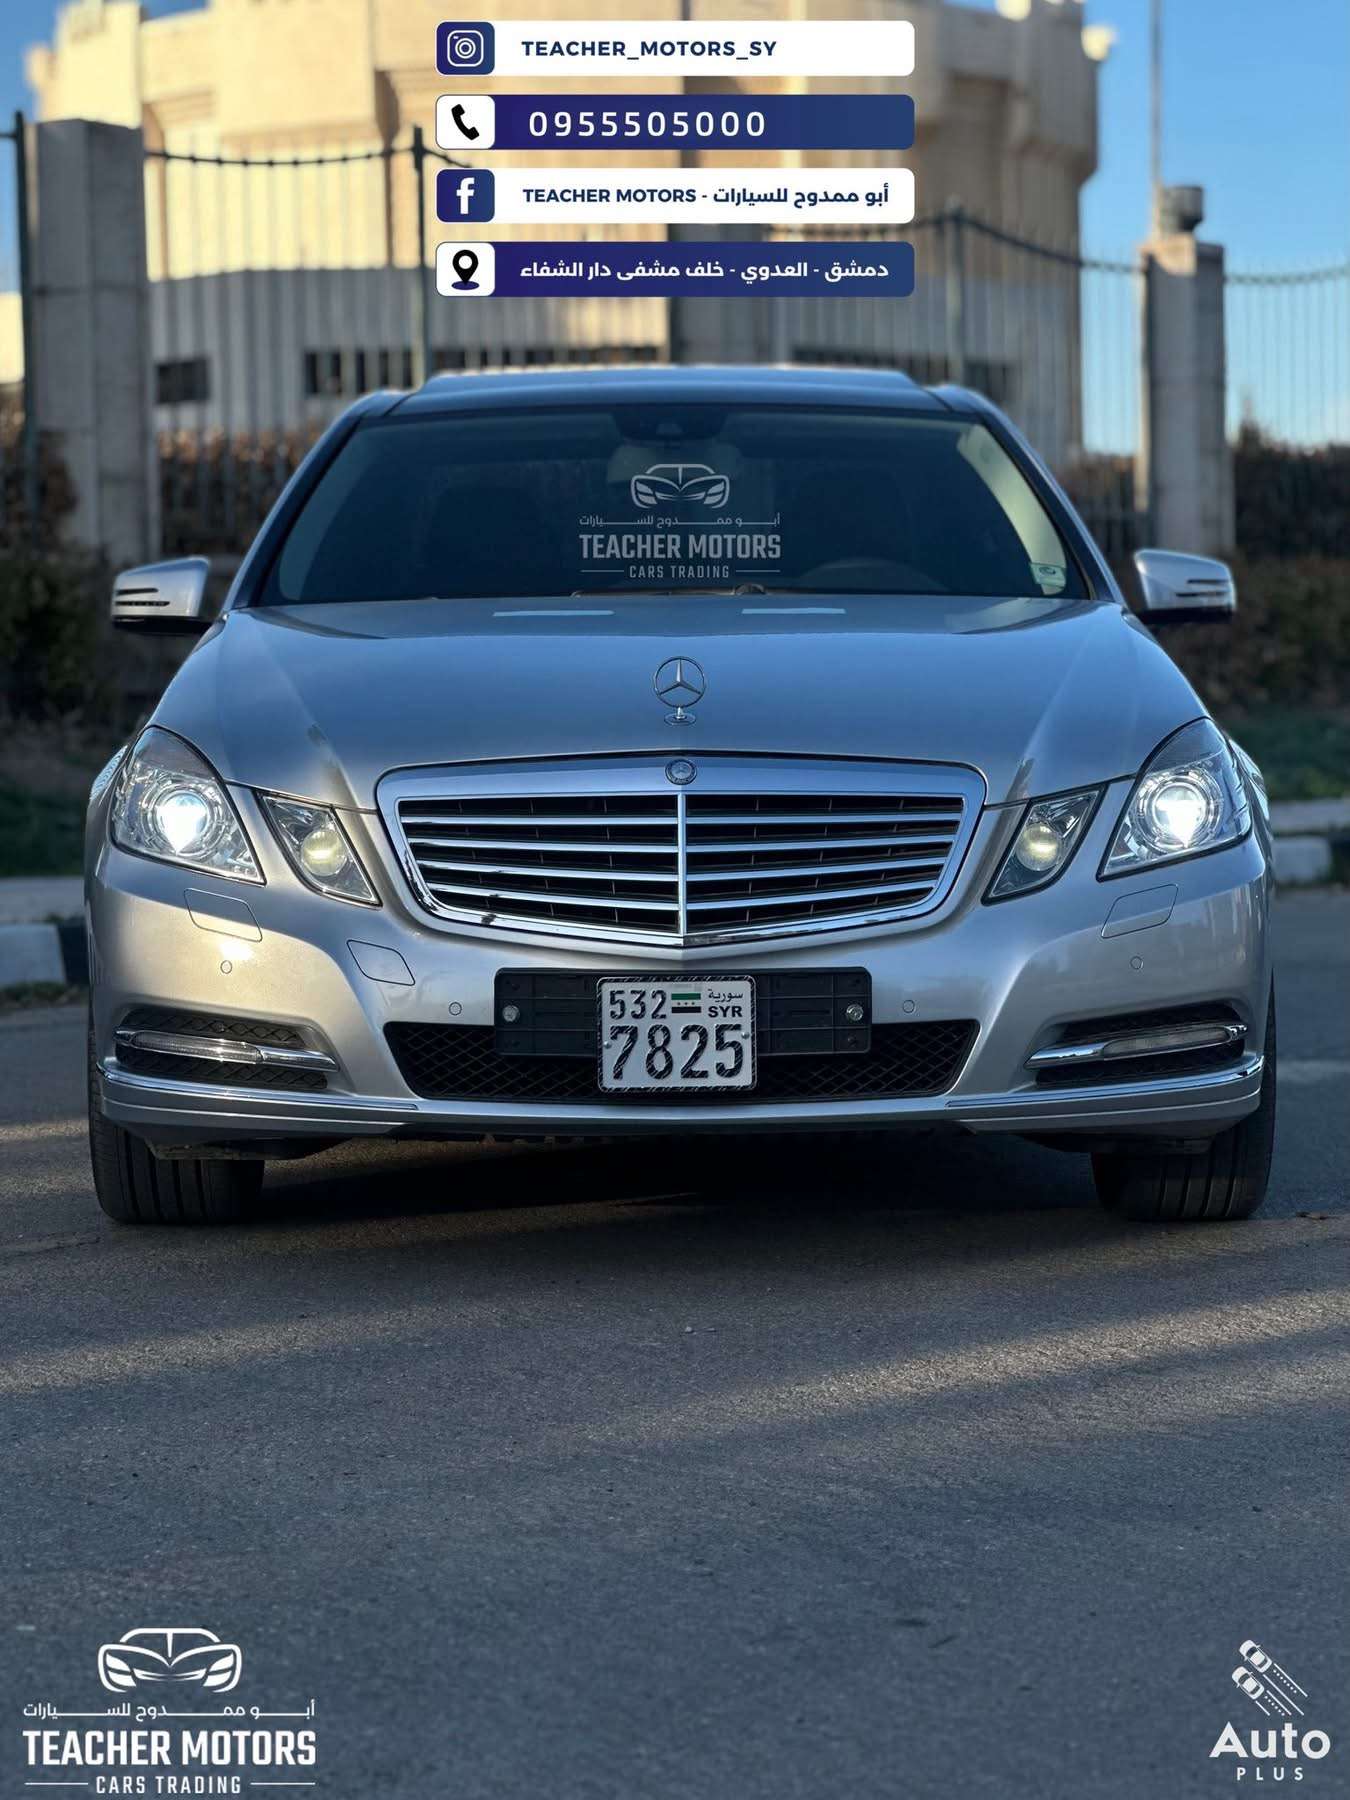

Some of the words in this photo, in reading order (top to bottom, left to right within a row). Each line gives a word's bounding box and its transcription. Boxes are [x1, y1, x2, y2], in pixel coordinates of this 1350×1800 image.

[609, 989, 667, 1020] 532
[707, 988, 744, 1003] سورية
[707, 1005, 743, 1018] SYR
[609, 1023, 744, 1080] 7825
